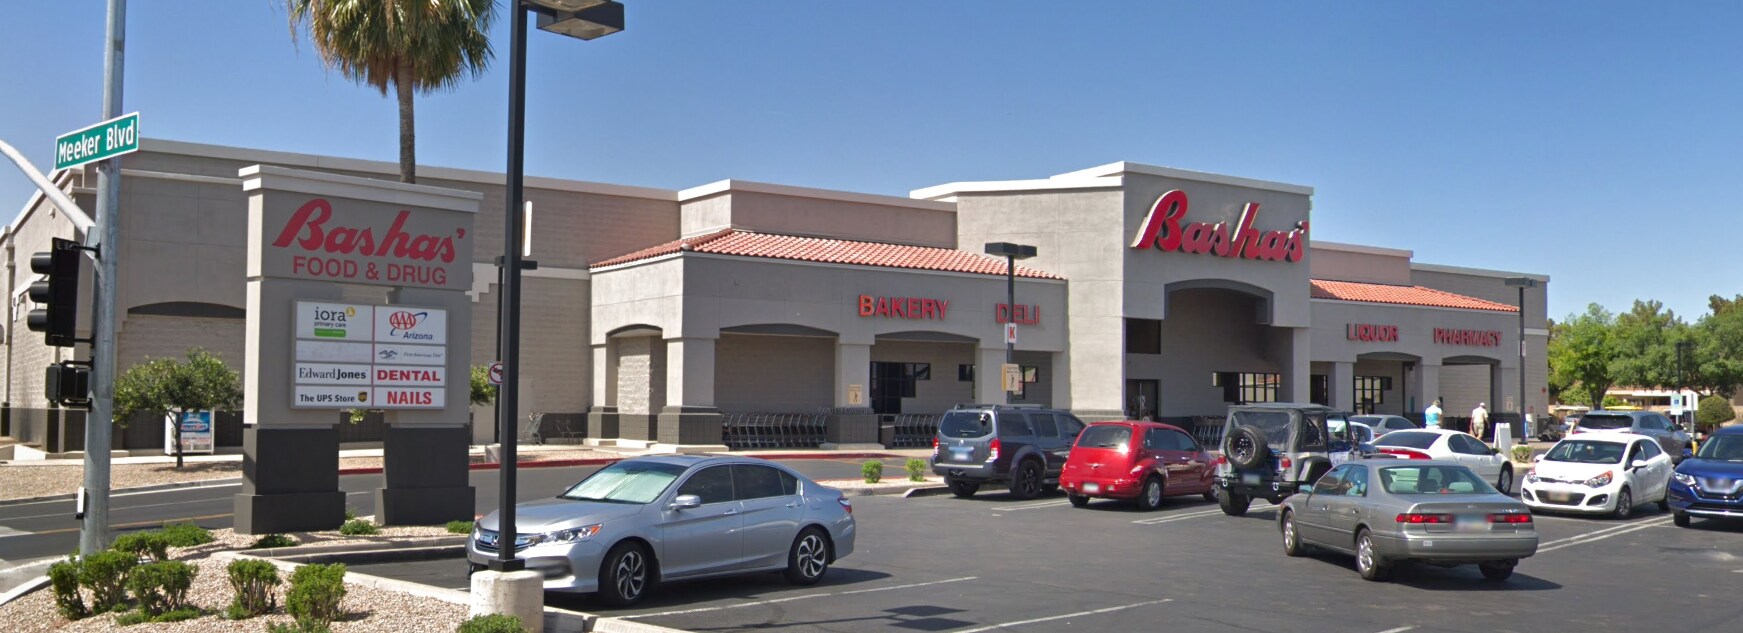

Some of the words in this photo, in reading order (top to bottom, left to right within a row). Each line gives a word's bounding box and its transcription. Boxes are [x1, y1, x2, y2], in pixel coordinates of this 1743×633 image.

[58, 134, 101, 164] Meeker
[106, 119, 134, 151] Blvd
[271, 198, 466, 263] Bashas'
[292, 255, 358, 278] FOOD
[365, 262, 380, 280] &
[387, 263, 447, 285] DRUG
[314, 306, 347, 322] iora
[858, 294, 950, 320] BAKERY
[996, 302, 1041, 325] DELI
[391, 313, 415, 329] AAA
[403, 331, 433, 340] Arizona
[1009, 326, 1016, 339] K
[1346, 323, 1399, 342] LIQUOR
[1433, 327, 1503, 347] PHARMACY
[377, 370, 441, 382] DENTAL
[300, 394, 314, 403] The
[317, 394, 333, 403] UPS
[335, 395, 355, 403] Store
[387, 391, 432, 405] NAILS
